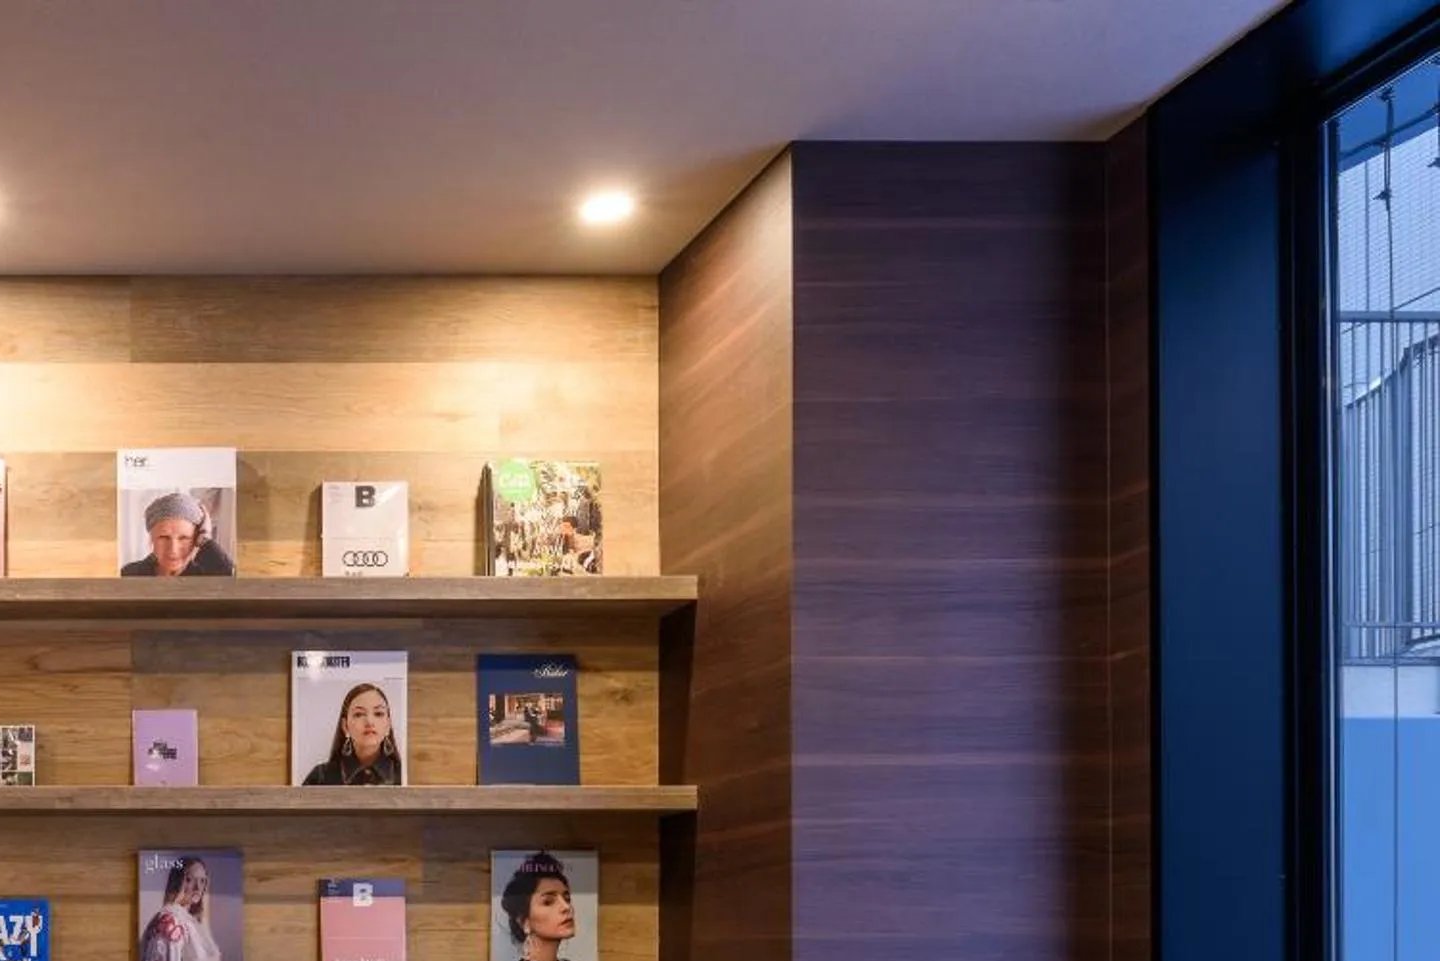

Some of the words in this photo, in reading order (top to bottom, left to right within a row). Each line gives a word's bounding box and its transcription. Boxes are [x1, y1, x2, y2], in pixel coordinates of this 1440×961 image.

[355, 485, 376, 508] B
[144, 852, 184, 874] glass
[353, 883, 374, 907] B
